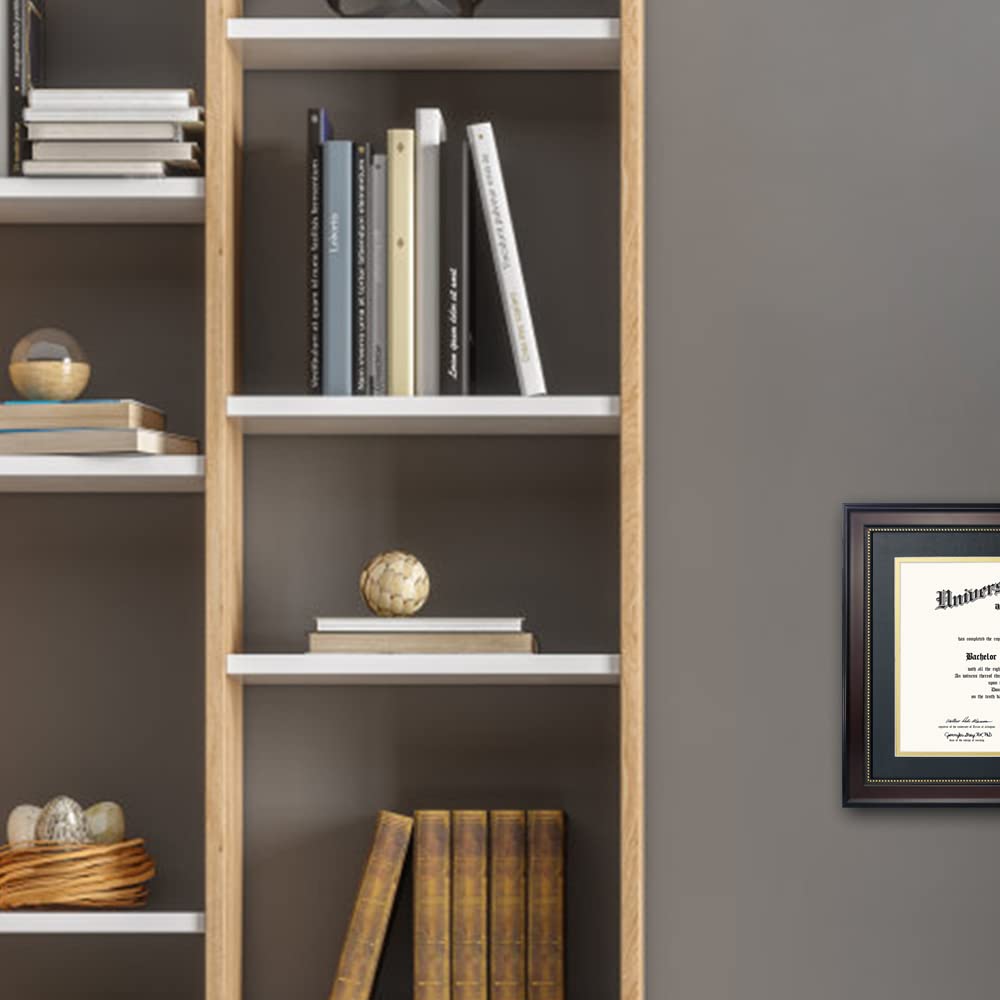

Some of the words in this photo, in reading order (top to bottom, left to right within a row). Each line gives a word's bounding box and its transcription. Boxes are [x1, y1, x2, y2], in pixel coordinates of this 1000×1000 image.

[448, 303, 458, 324] dolor
[449, 326, 459, 351] ipsum
[448, 353, 458, 380] Lorem
[966, 652, 997, 661] Bachelor
